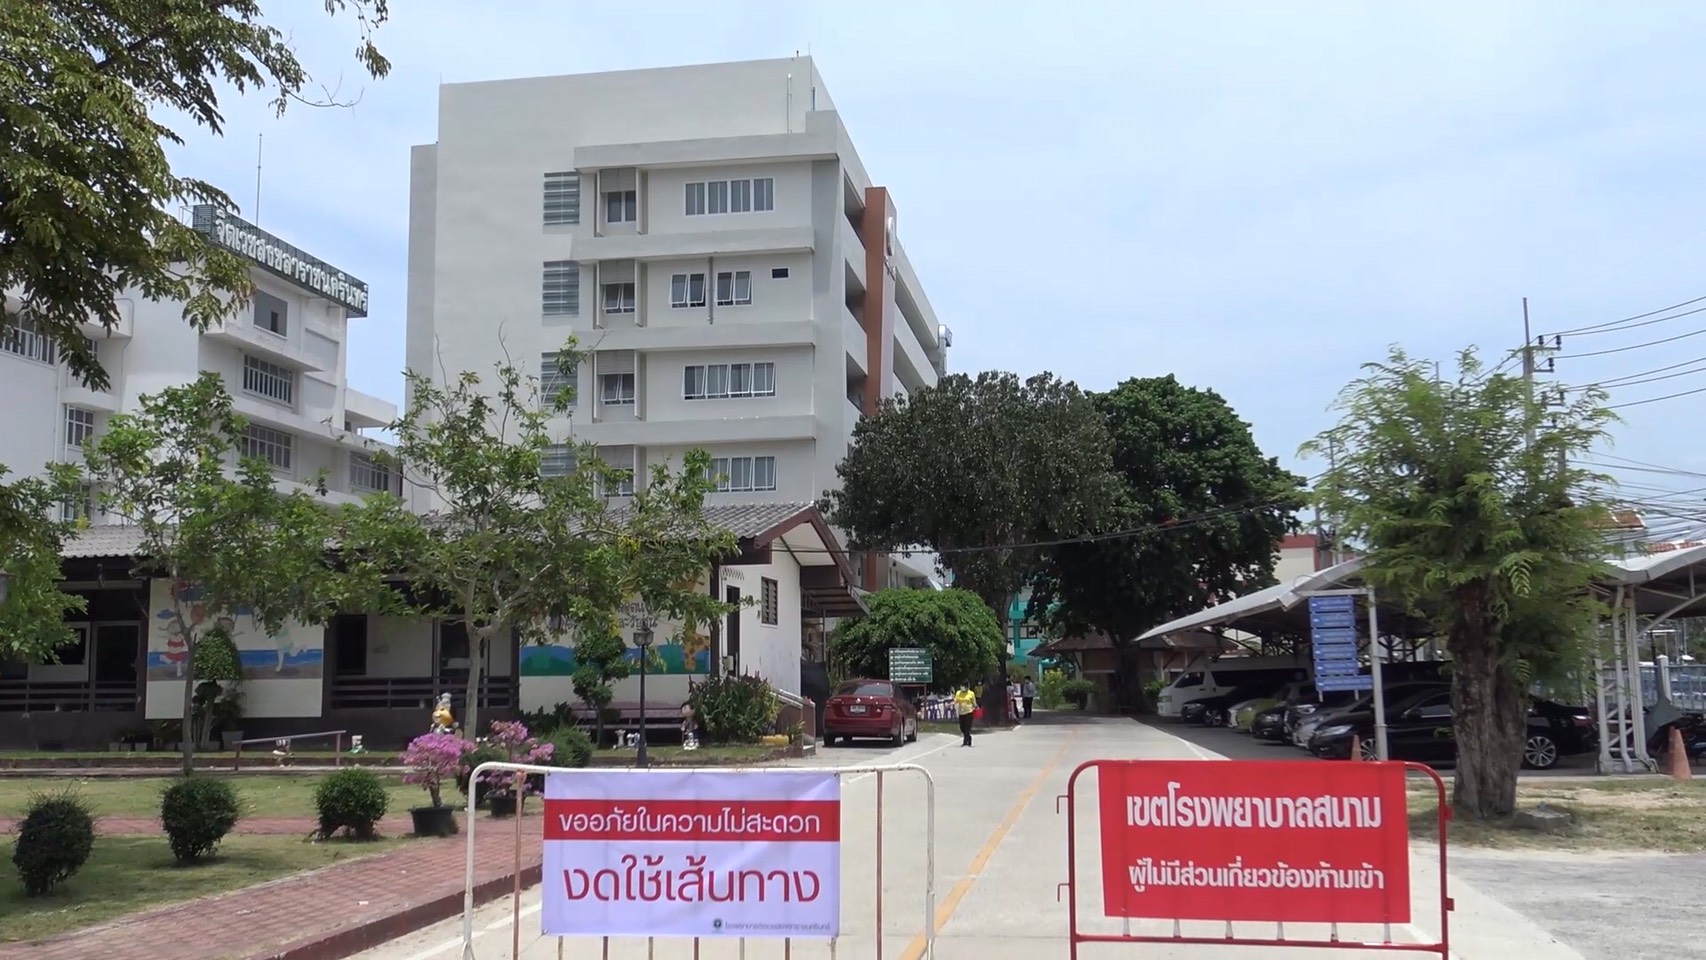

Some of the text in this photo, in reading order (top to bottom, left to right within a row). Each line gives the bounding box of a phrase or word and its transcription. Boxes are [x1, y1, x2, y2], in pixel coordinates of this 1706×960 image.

[559, 806, 820, 833] ขออภัยในความไม่สะดวก
[1126, 781, 1382, 828] เขตโรงพยาบาลสนาม
[563, 854, 820, 903] งดใช้เส้นทาง
[1128, 855, 1384, 893] ผู้ไม่มีส่วนเกี่ยวข้องห้ามเข้า
